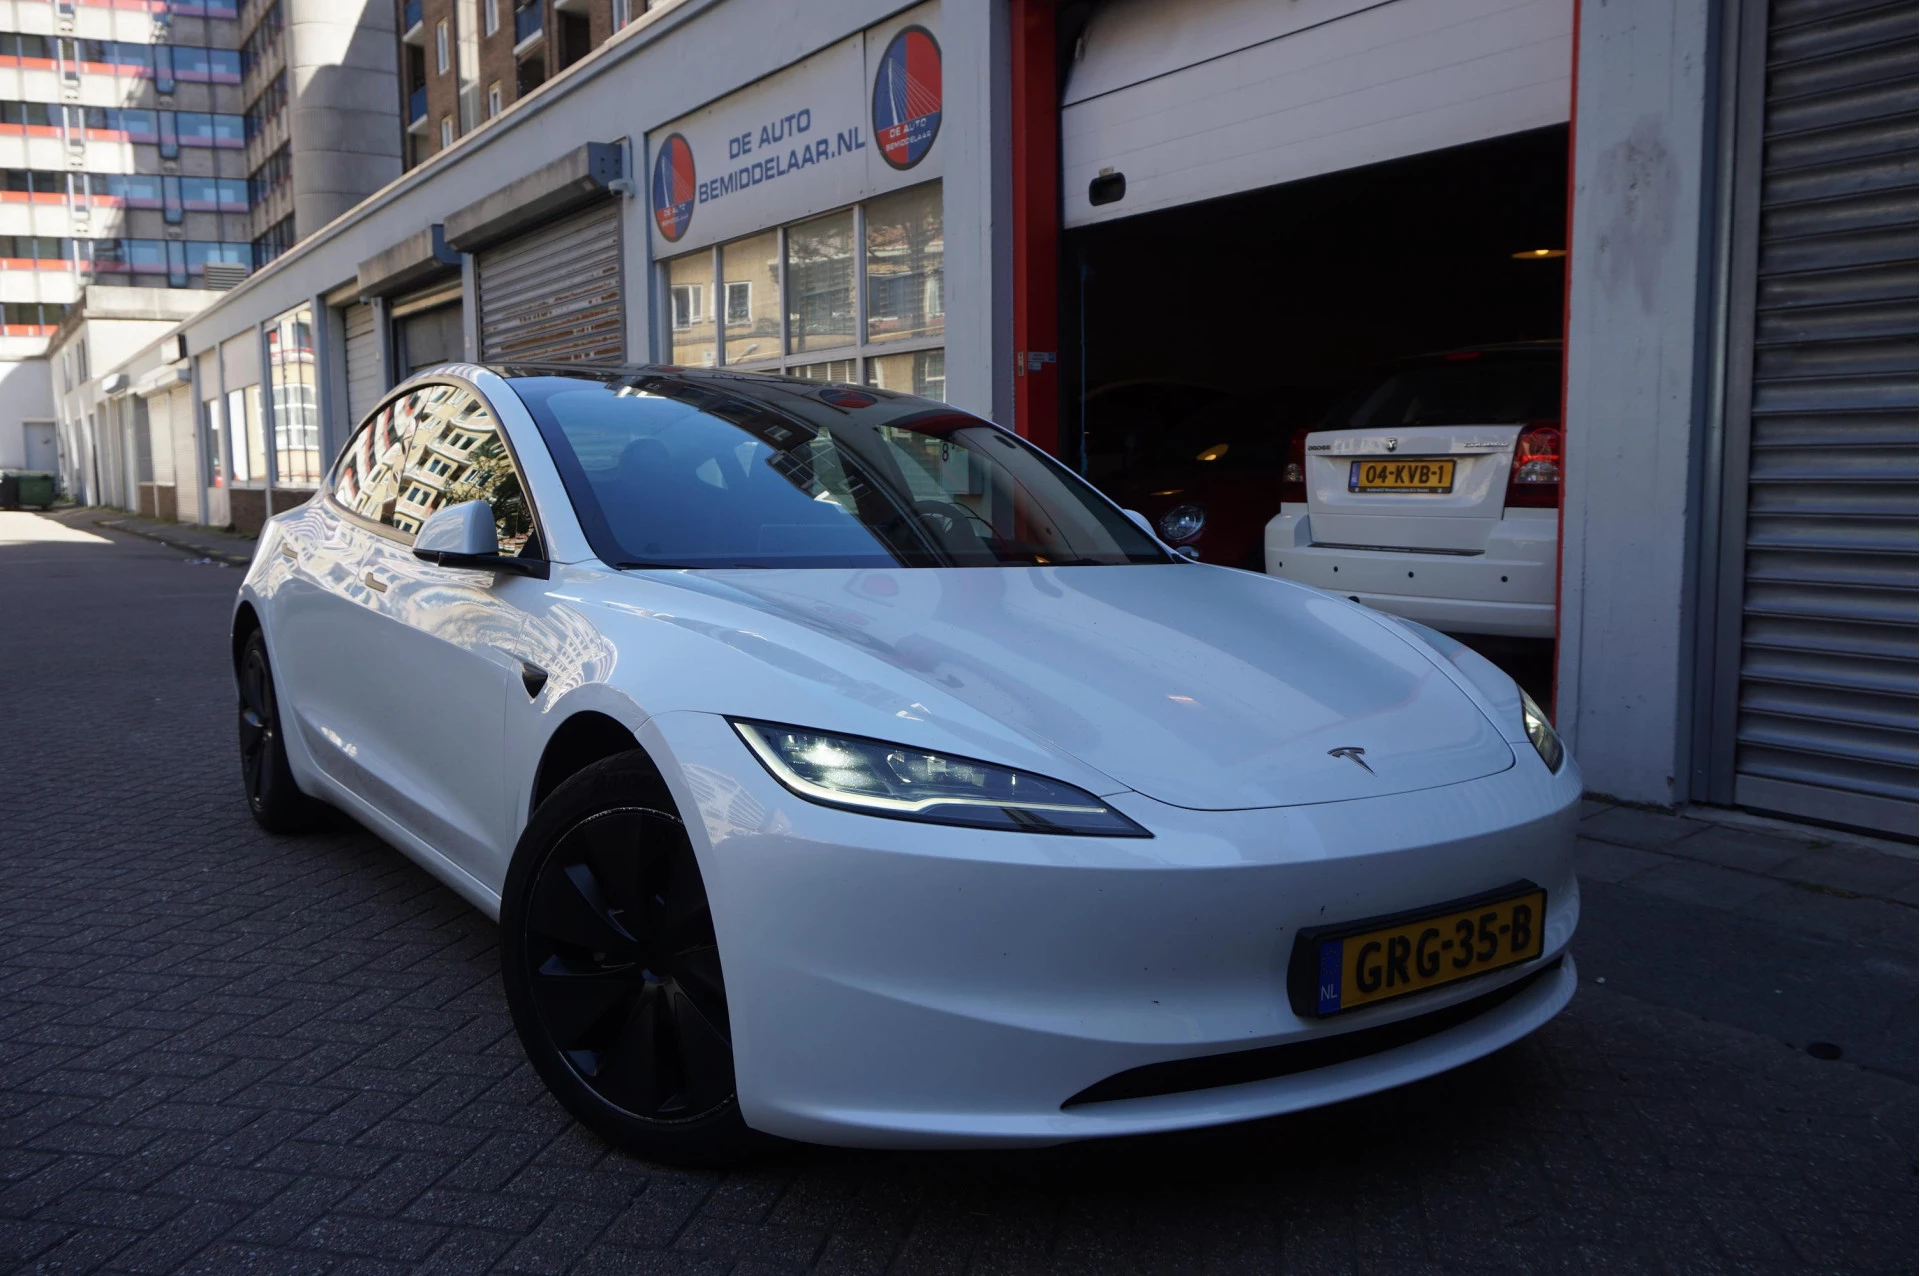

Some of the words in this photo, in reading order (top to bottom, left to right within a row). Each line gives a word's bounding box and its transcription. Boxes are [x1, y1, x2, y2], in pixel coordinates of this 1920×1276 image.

[729, 132, 752, 160] DE
[758, 108, 811, 149] AUTO
[889, 126, 901, 138] DE
[903, 117, 927, 133] AUTO
[699, 126, 866, 204] BEMIDDELAAR.NL
[1365, 464, 1445, 484] 04-KVB-1
[1355, 904, 1532, 993] GRG-35-B
[1320, 984, 1338, 1000] NL
